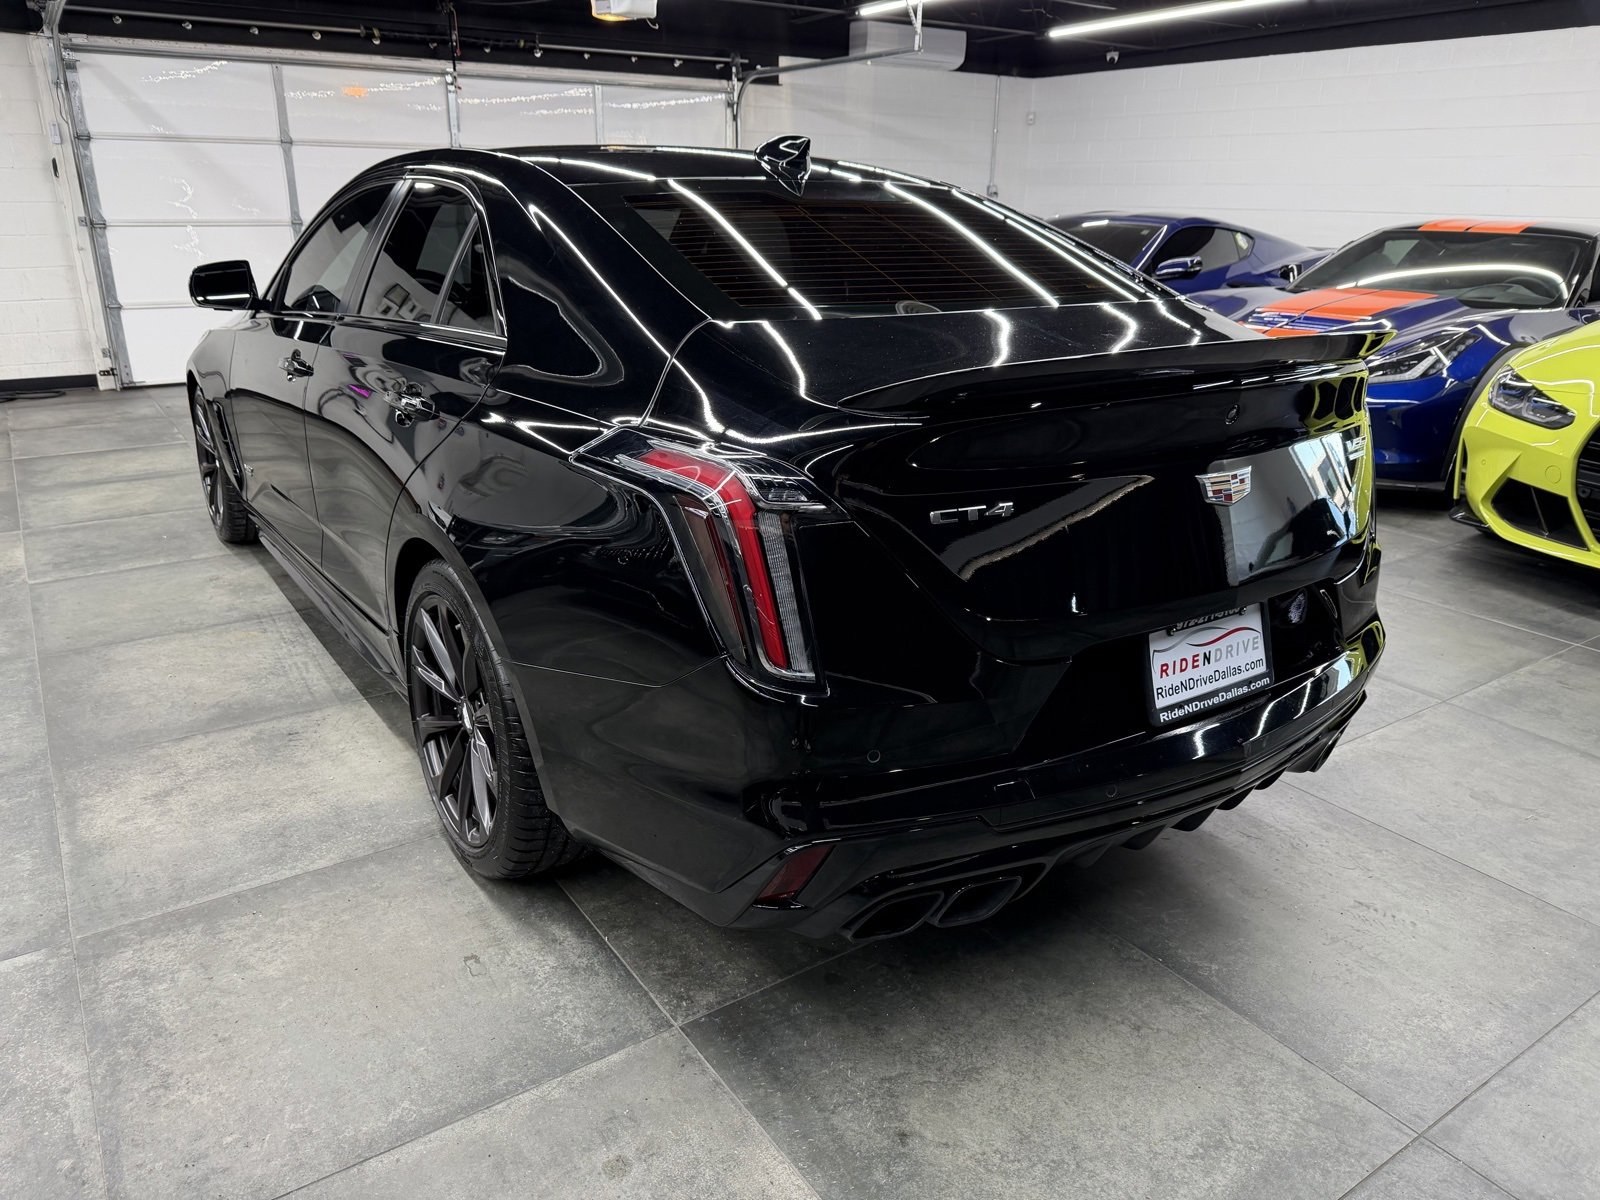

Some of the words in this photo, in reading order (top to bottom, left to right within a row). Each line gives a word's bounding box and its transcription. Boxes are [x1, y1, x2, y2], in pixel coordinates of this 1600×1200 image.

[930, 501, 1015, 525] CT4
[1156, 657, 1264, 701] RideNDriveDallas.com
[1160, 636, 1260, 679] RIDENDRIVE
[1159, 676, 1270, 723] RideNDriveDallas.com
